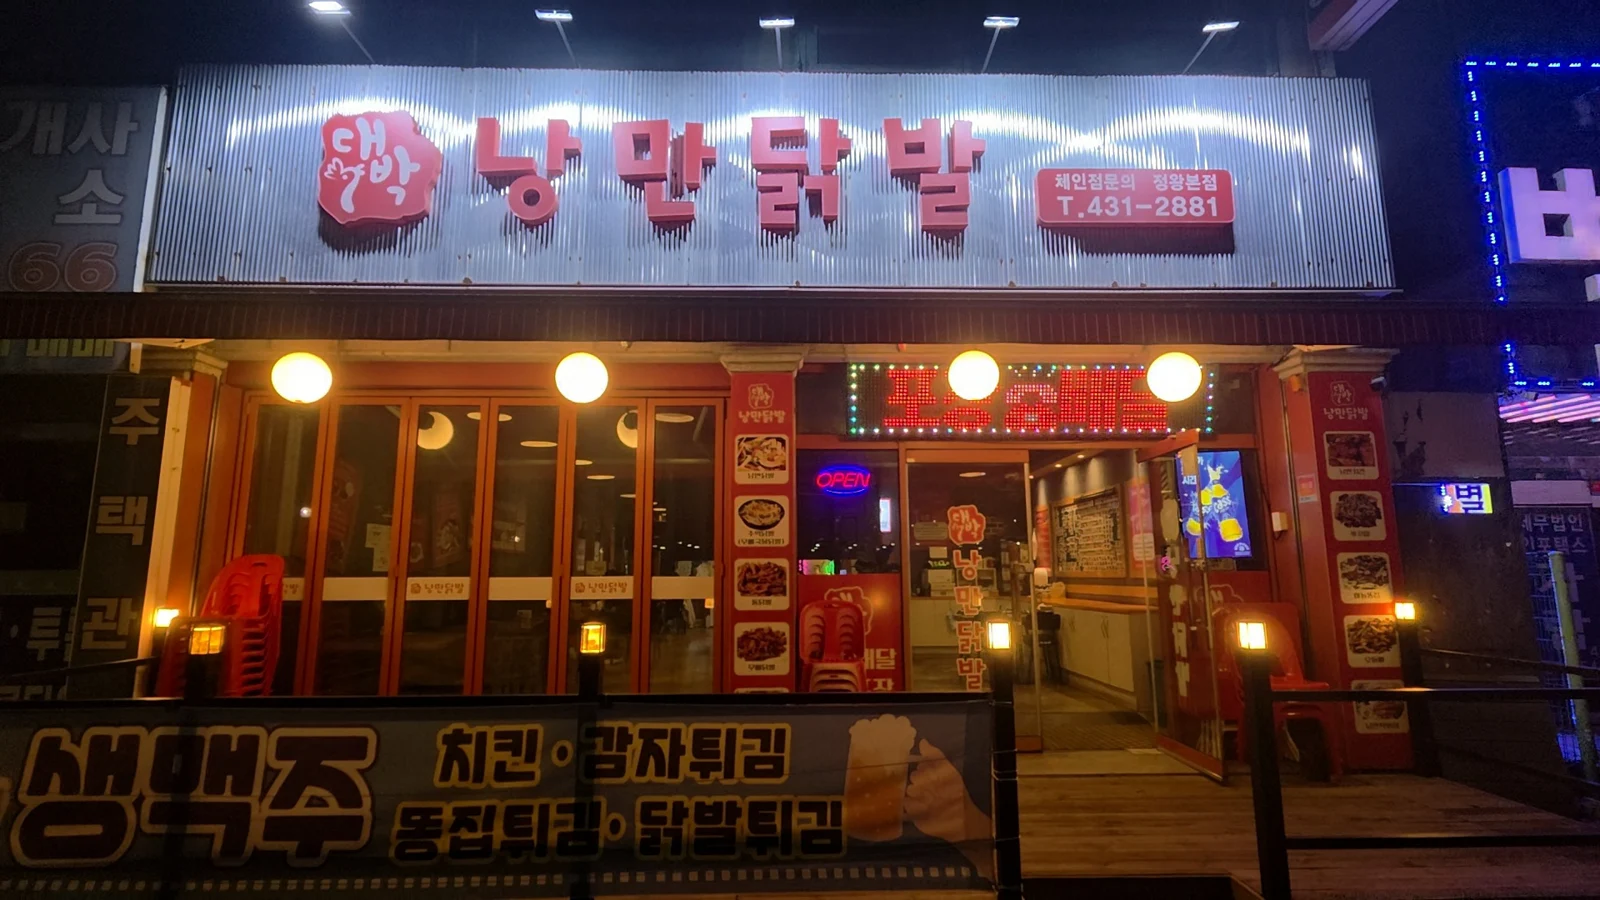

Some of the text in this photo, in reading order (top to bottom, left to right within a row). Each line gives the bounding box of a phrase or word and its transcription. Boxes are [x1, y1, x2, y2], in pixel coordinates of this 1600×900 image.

[331, 116, 421, 207] 대박
[475, 116, 986, 229] 낭만닭발
[1055, 173, 1218, 192] 체인점문의 정왕본점
[1056, 196, 1218, 219] T.431-2881
[738, 410, 786, 424] 낭만닭발
[1323, 407, 1369, 420] 낭만닭발
[816, 472, 871, 488] OPEN
[953, 550, 986, 692] 낭만닭발
[11, 727, 377, 867] 생맥주
